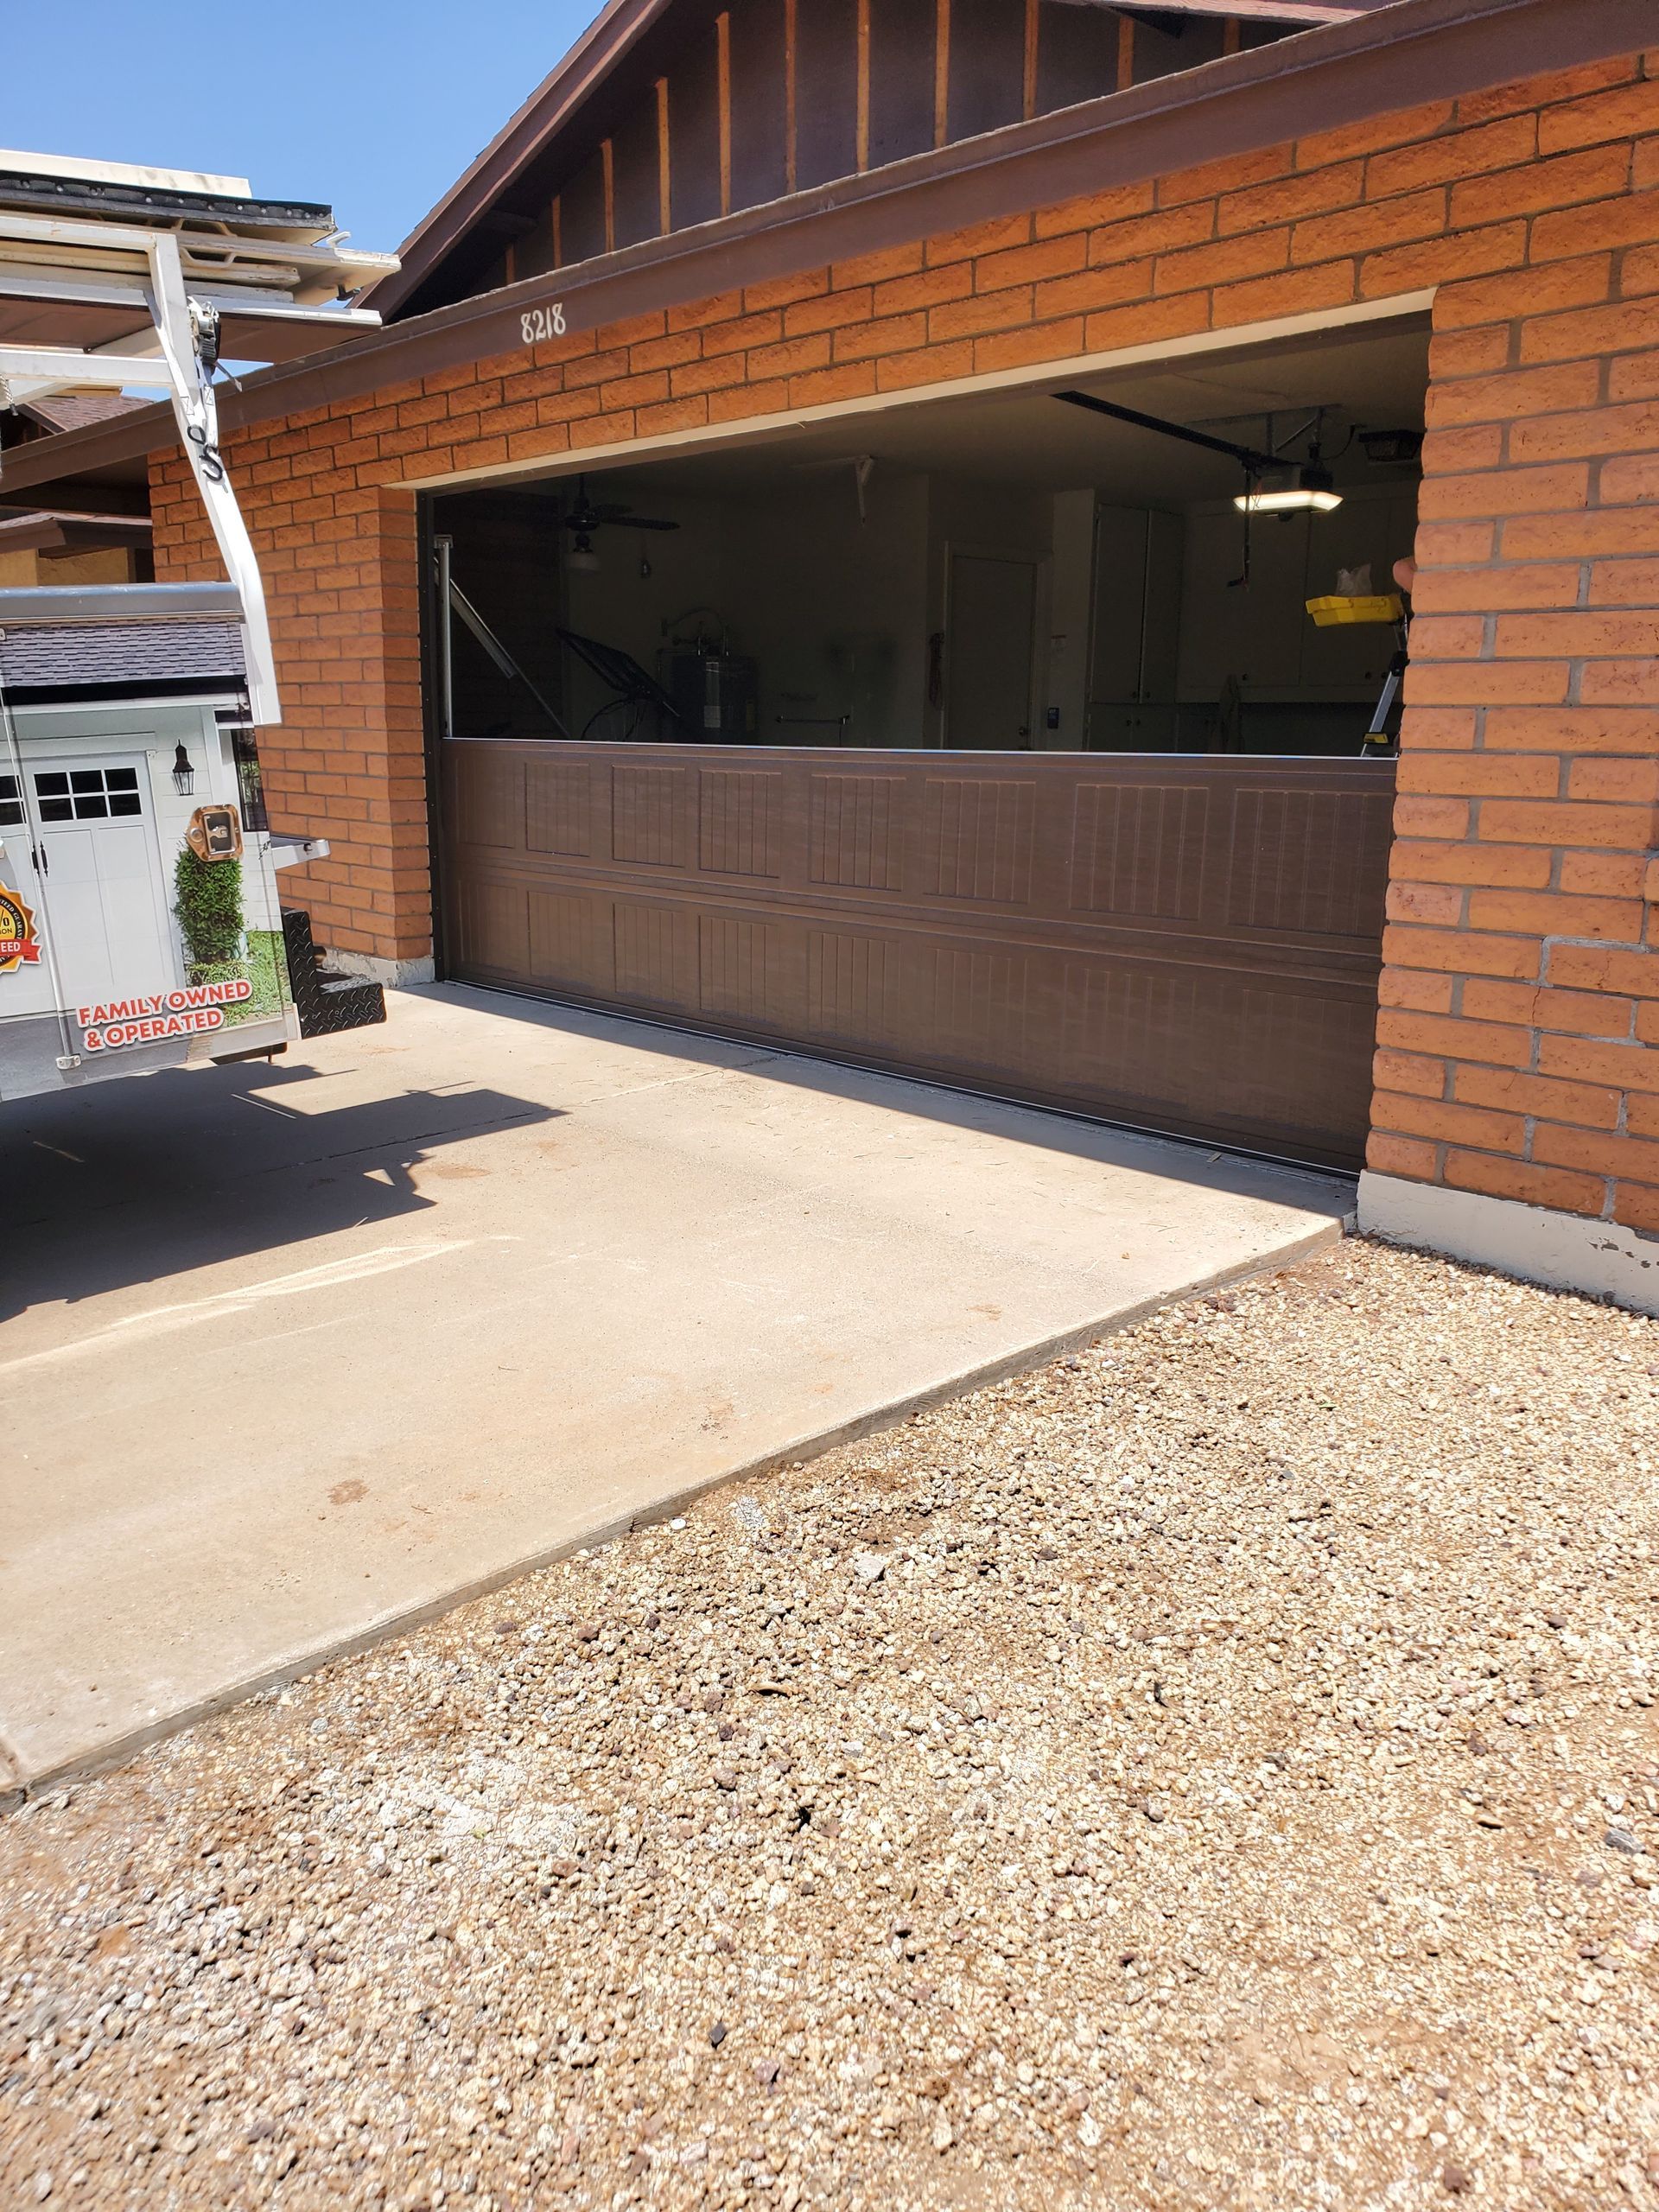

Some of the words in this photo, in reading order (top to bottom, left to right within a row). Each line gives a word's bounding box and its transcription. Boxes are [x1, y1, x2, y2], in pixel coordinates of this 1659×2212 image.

[520, 302, 566, 343] 8218
[79, 995, 163, 1025] FAMILY
[168, 982, 251, 1008] OWNED
[87, 1031, 102, 1048] &
[106, 1010, 222, 1045] OPERATED
